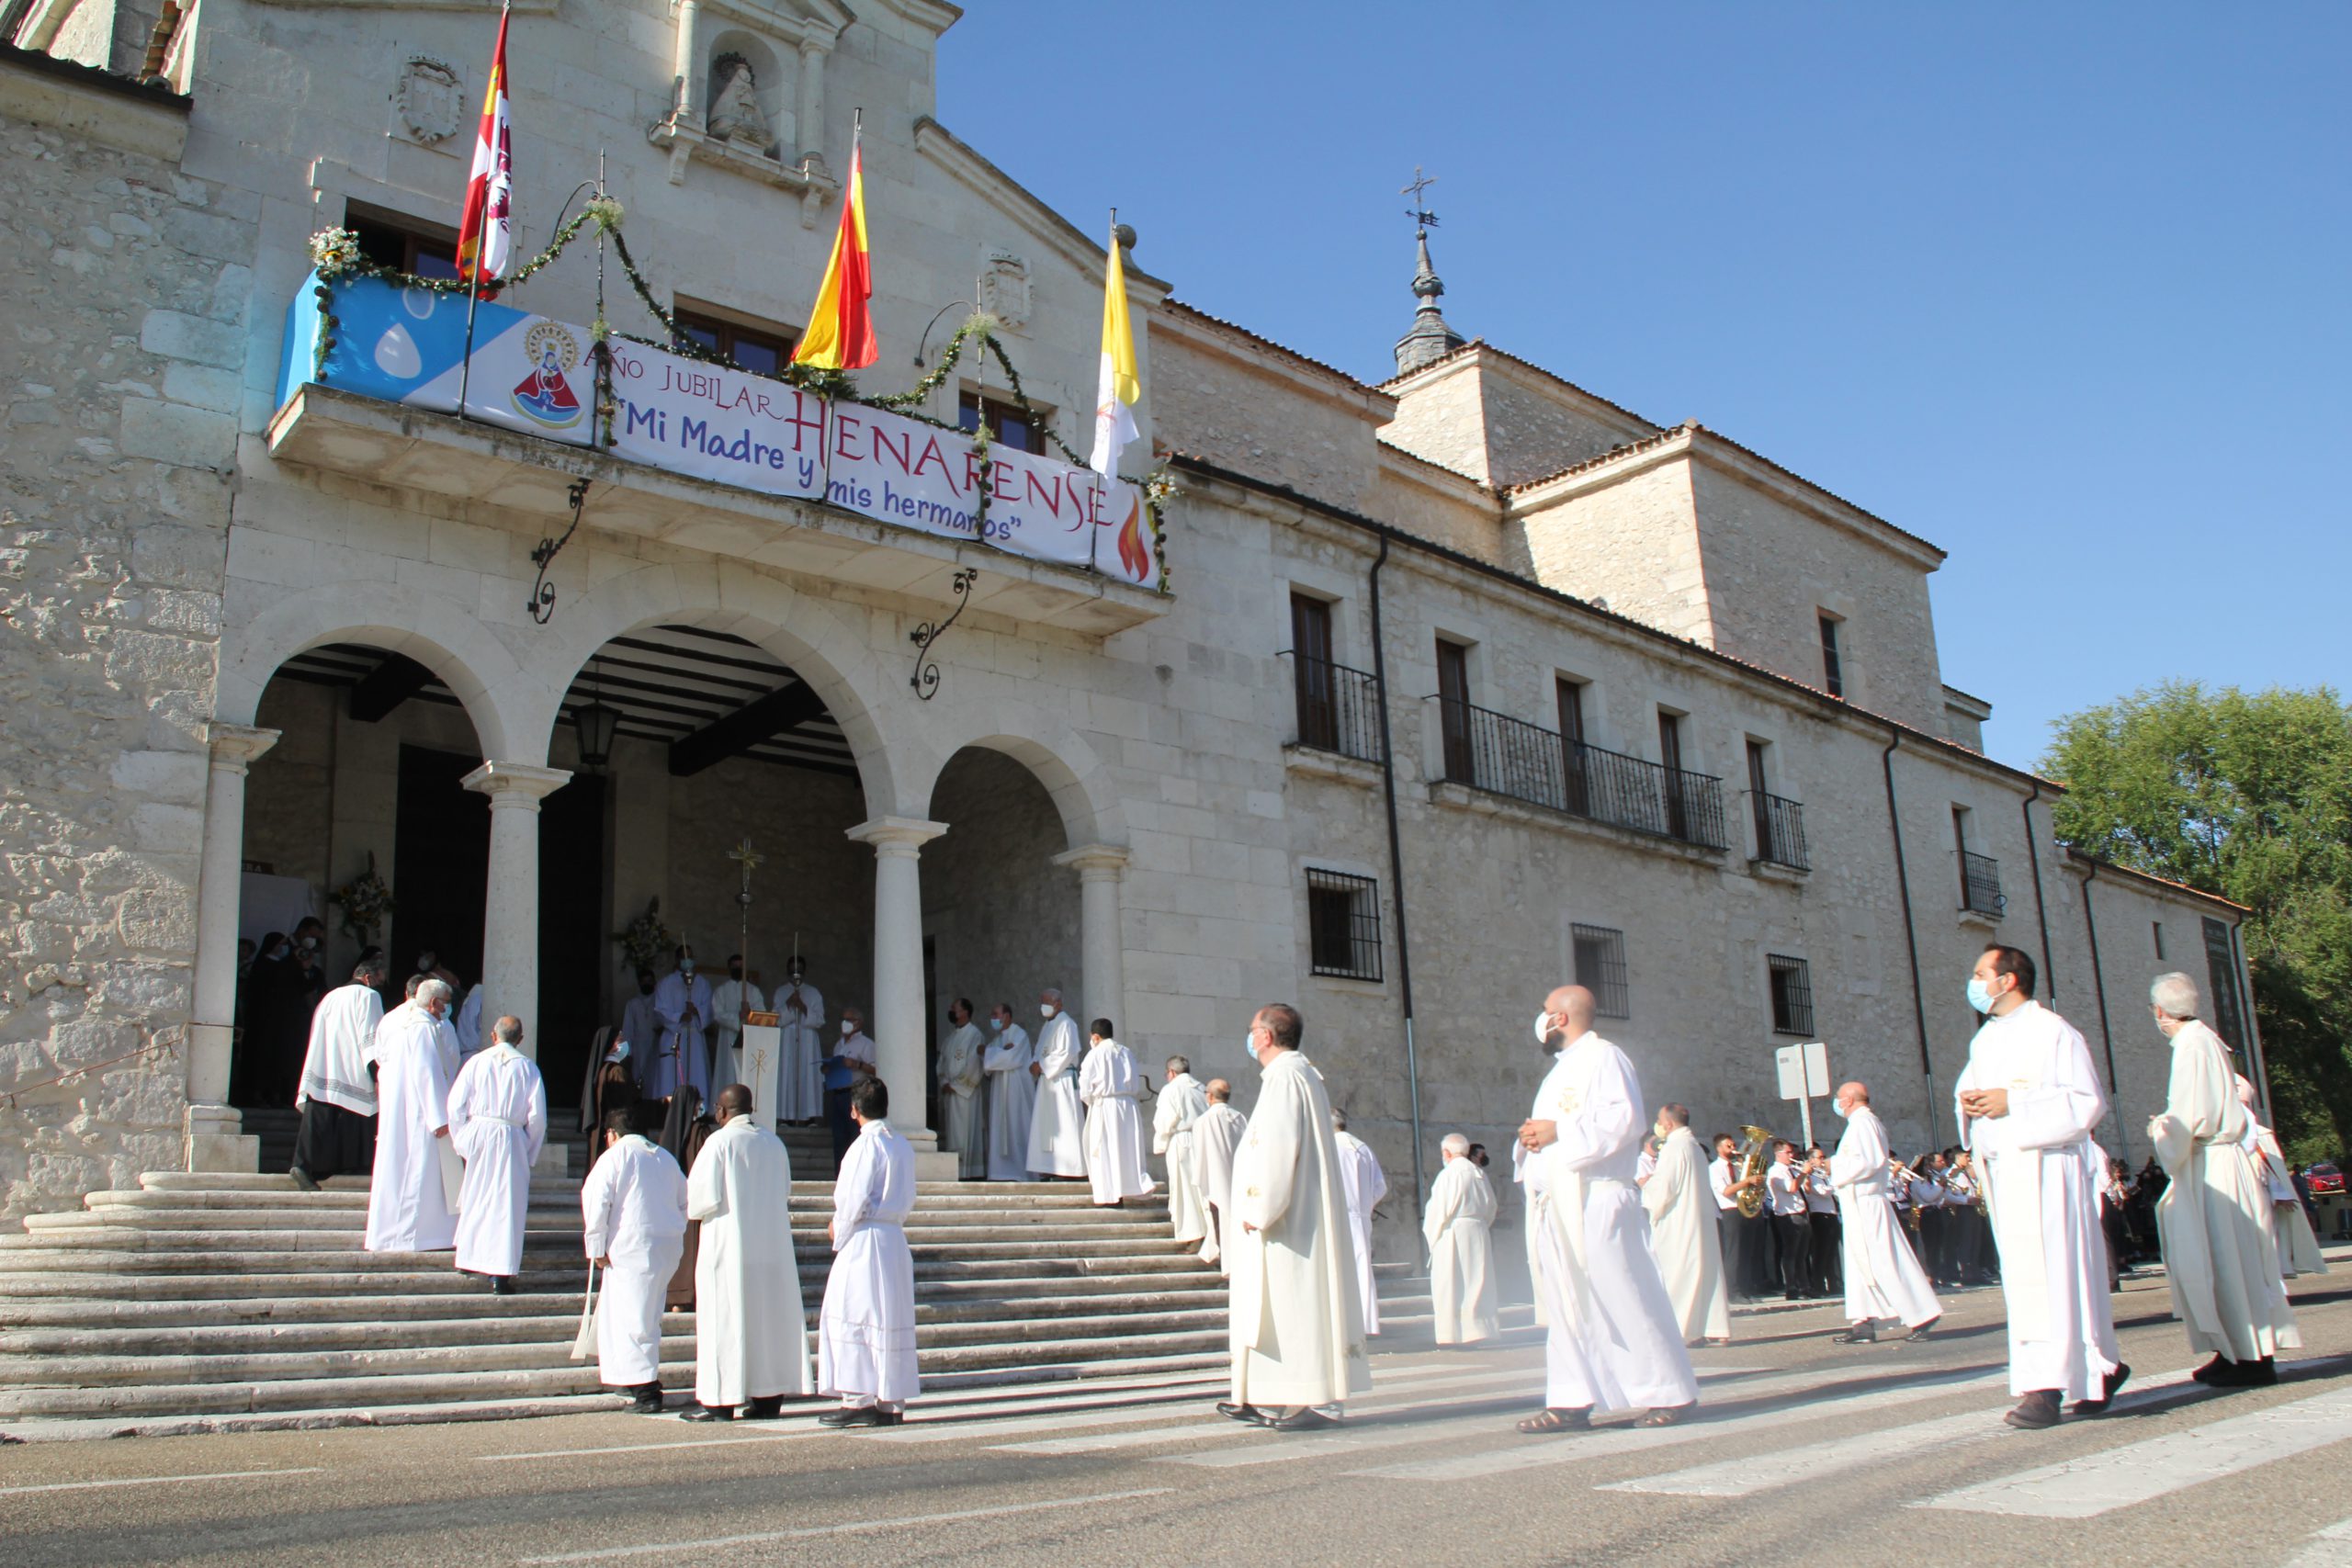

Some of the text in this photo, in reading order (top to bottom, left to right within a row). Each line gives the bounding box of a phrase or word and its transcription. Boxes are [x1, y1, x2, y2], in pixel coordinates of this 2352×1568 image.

[659, 365, 783, 420] JUBILAR
[785, 390, 1114, 532] HENARENSE
[681, 414, 785, 470] Madre
[798, 456, 814, 490] y
[827, 478, 872, 508] mis
